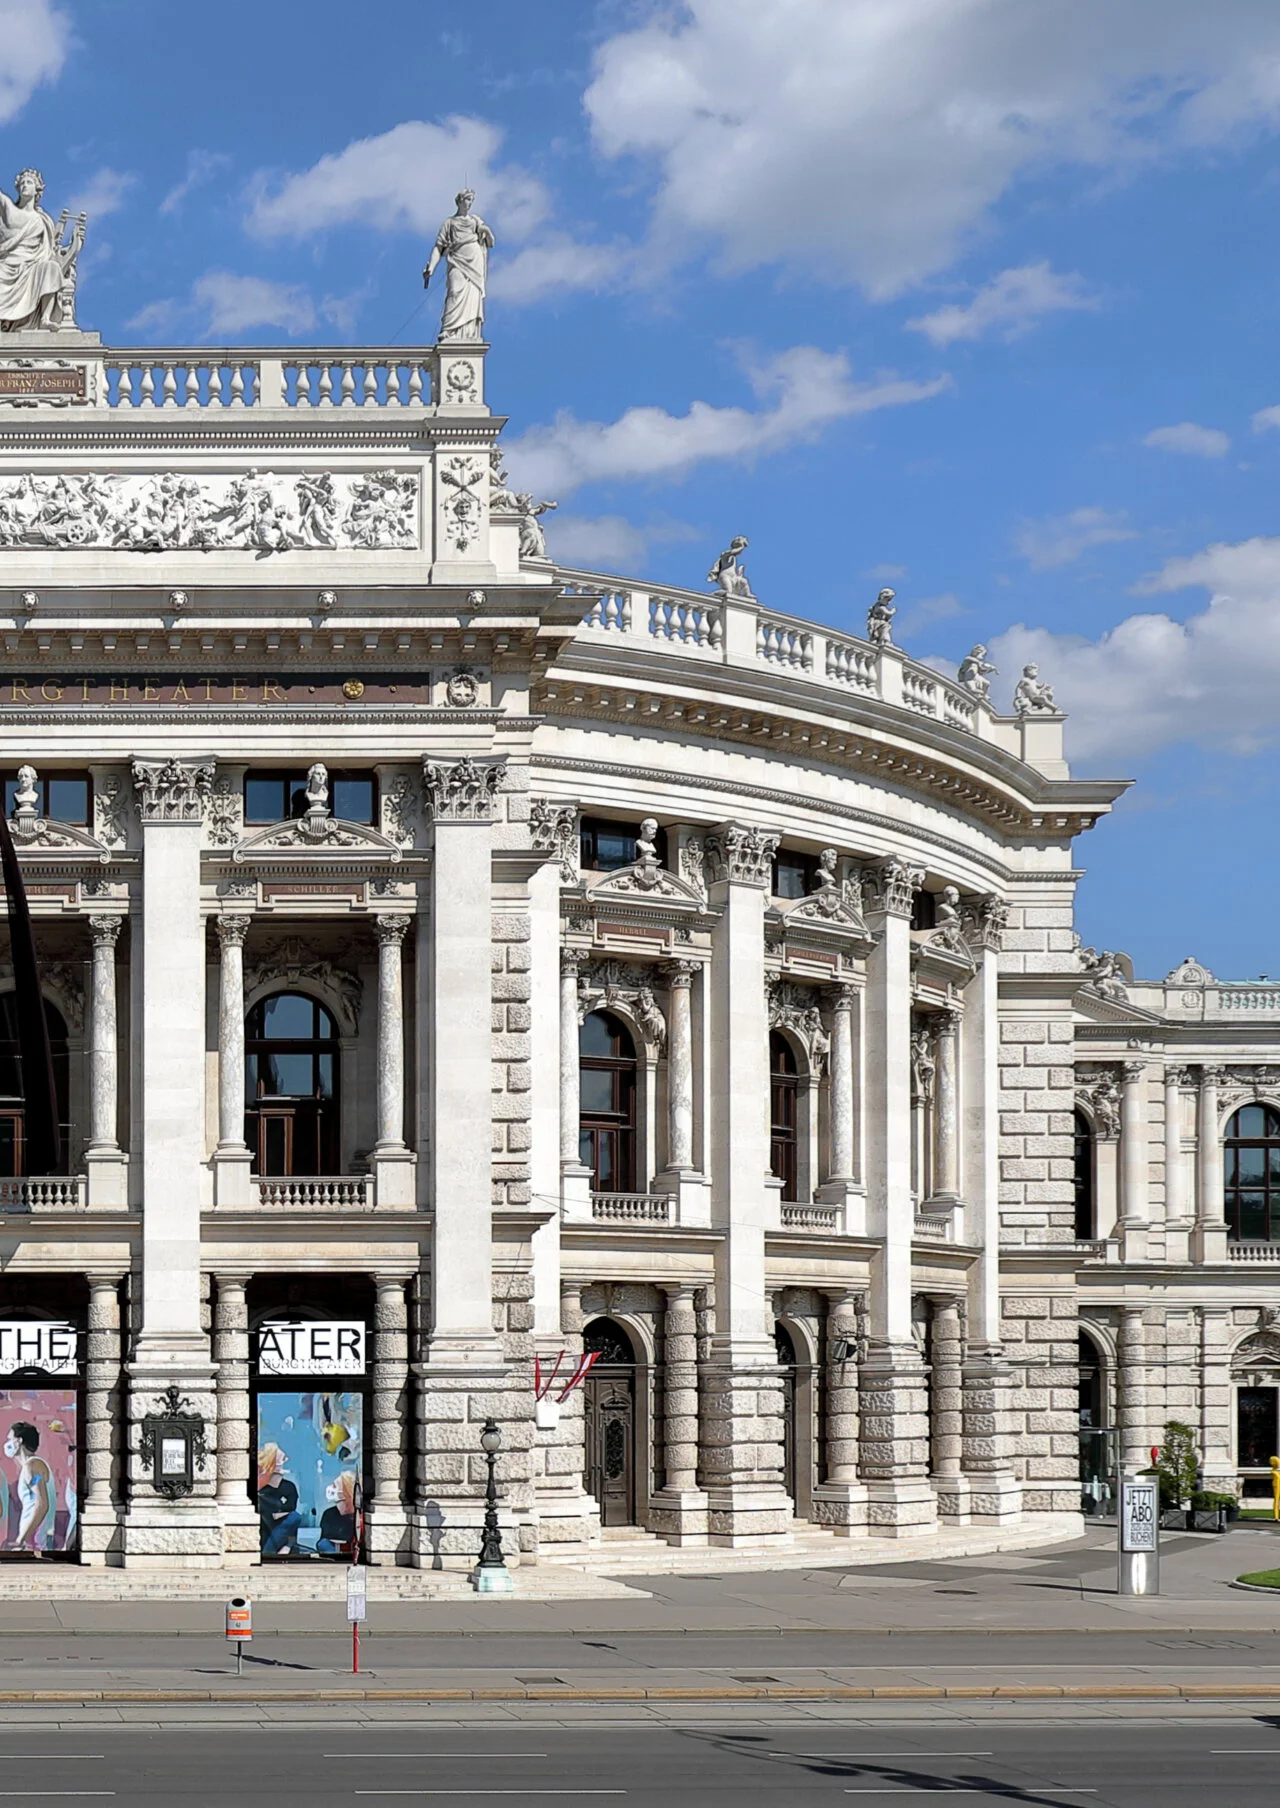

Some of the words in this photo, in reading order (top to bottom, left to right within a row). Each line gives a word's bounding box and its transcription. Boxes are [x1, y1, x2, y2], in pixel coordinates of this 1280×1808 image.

[7, 379, 37, 388] FRANZ
[40, 379, 76, 388] JOSEPH
[259, 1327, 361, 1360] ATER
[1125, 1489, 1152, 1506] JETZT
[1131, 1505, 1152, 1522] ABO
